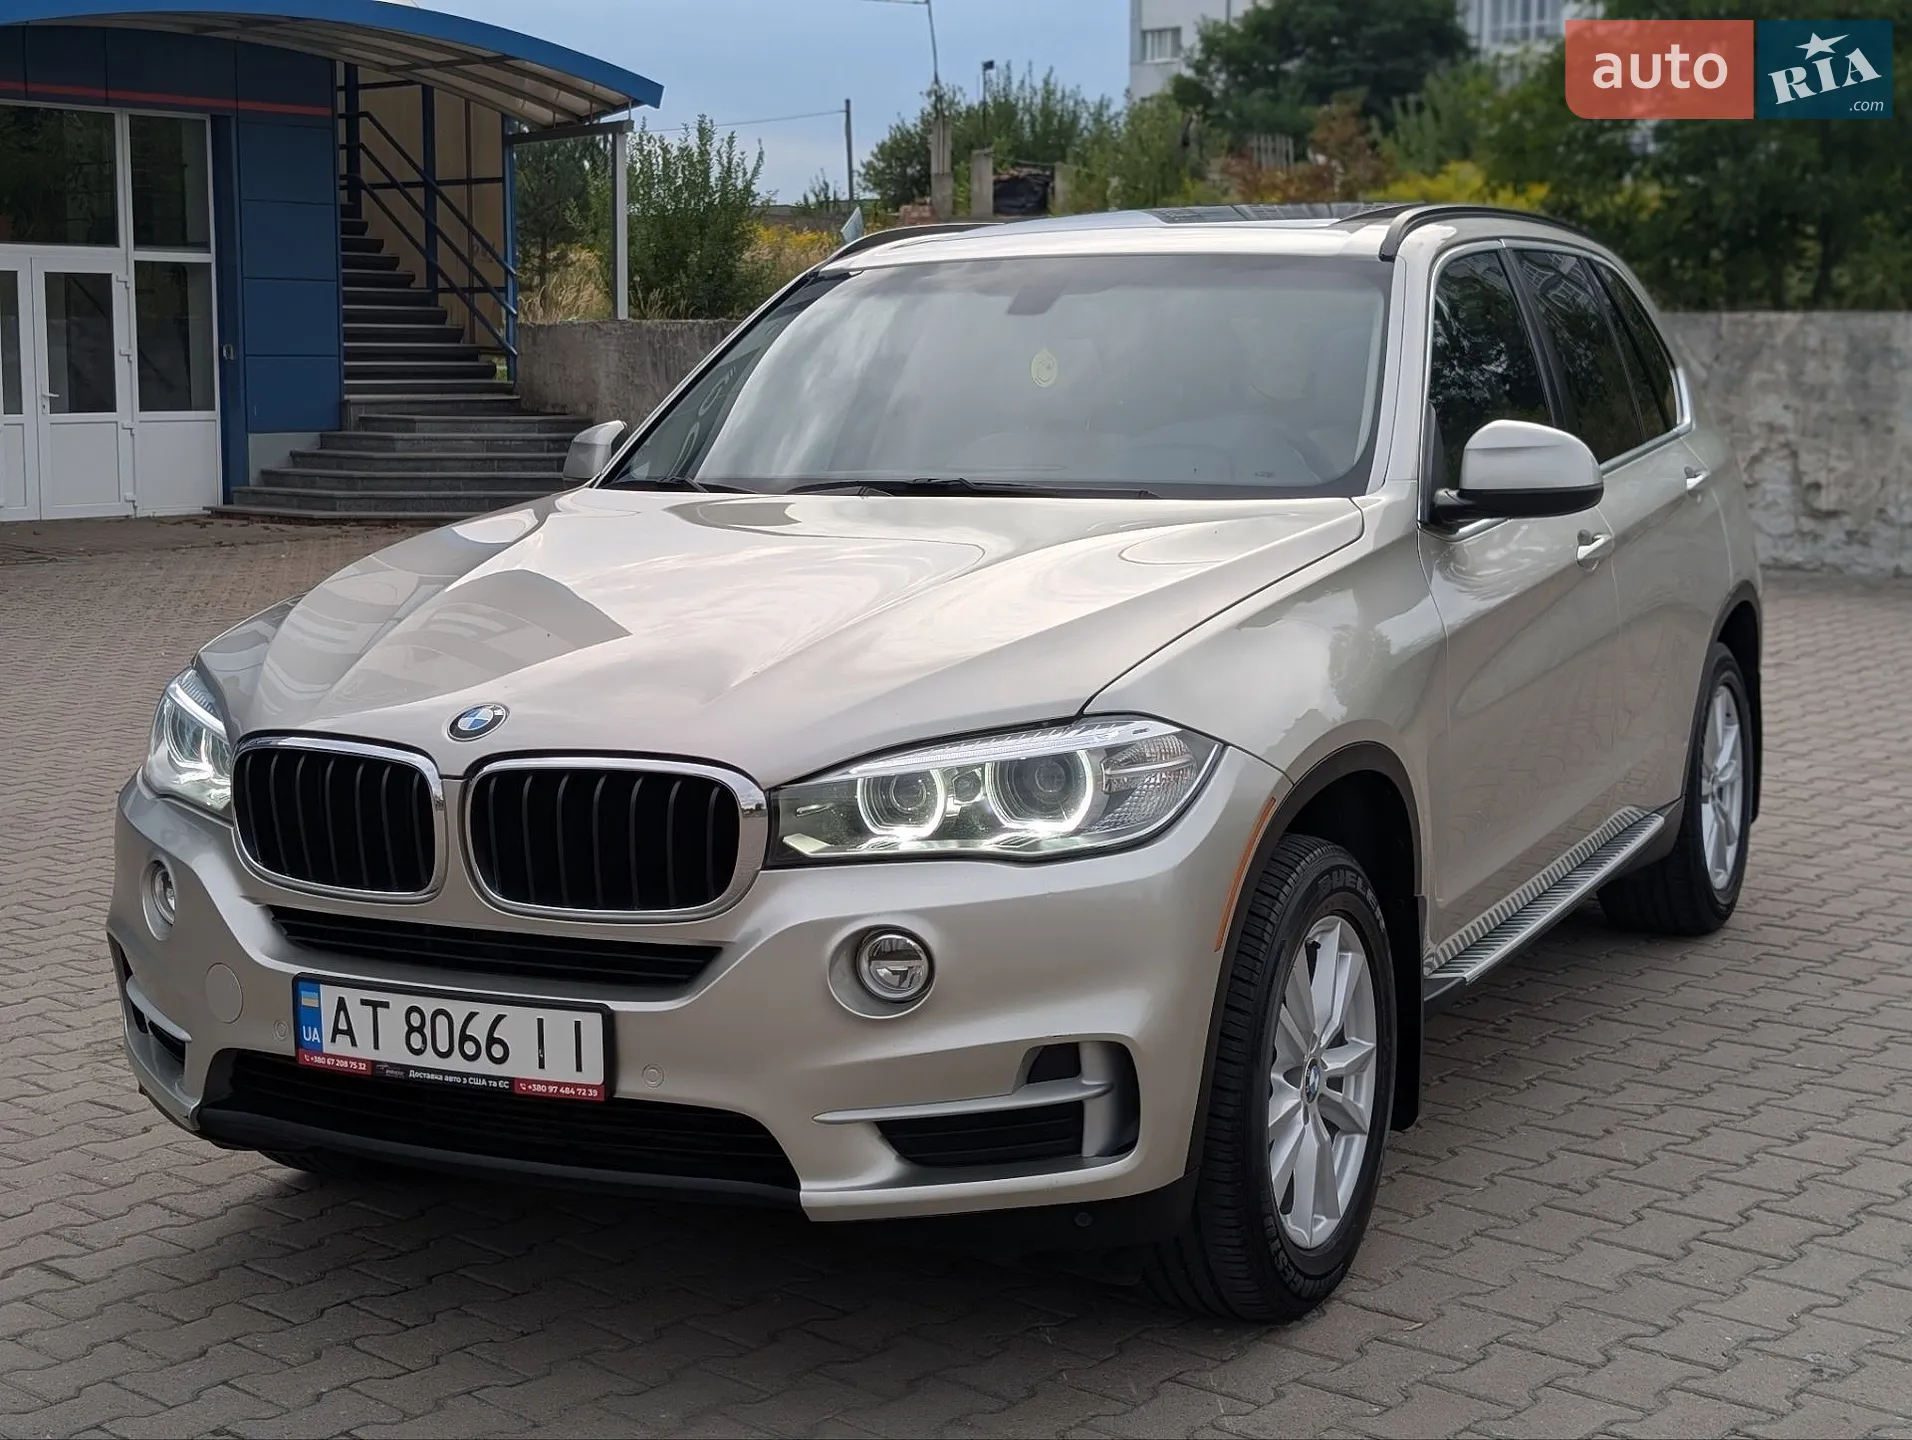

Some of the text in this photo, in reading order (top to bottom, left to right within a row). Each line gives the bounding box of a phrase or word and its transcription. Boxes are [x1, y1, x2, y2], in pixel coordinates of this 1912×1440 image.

[303, 1025, 321, 1044] UA
[330, 996, 390, 1051] AT
[404, 1005, 510, 1066] 8066
[409, 1069, 444, 1082] Доставка
[468, 1077, 487, 1086] США
